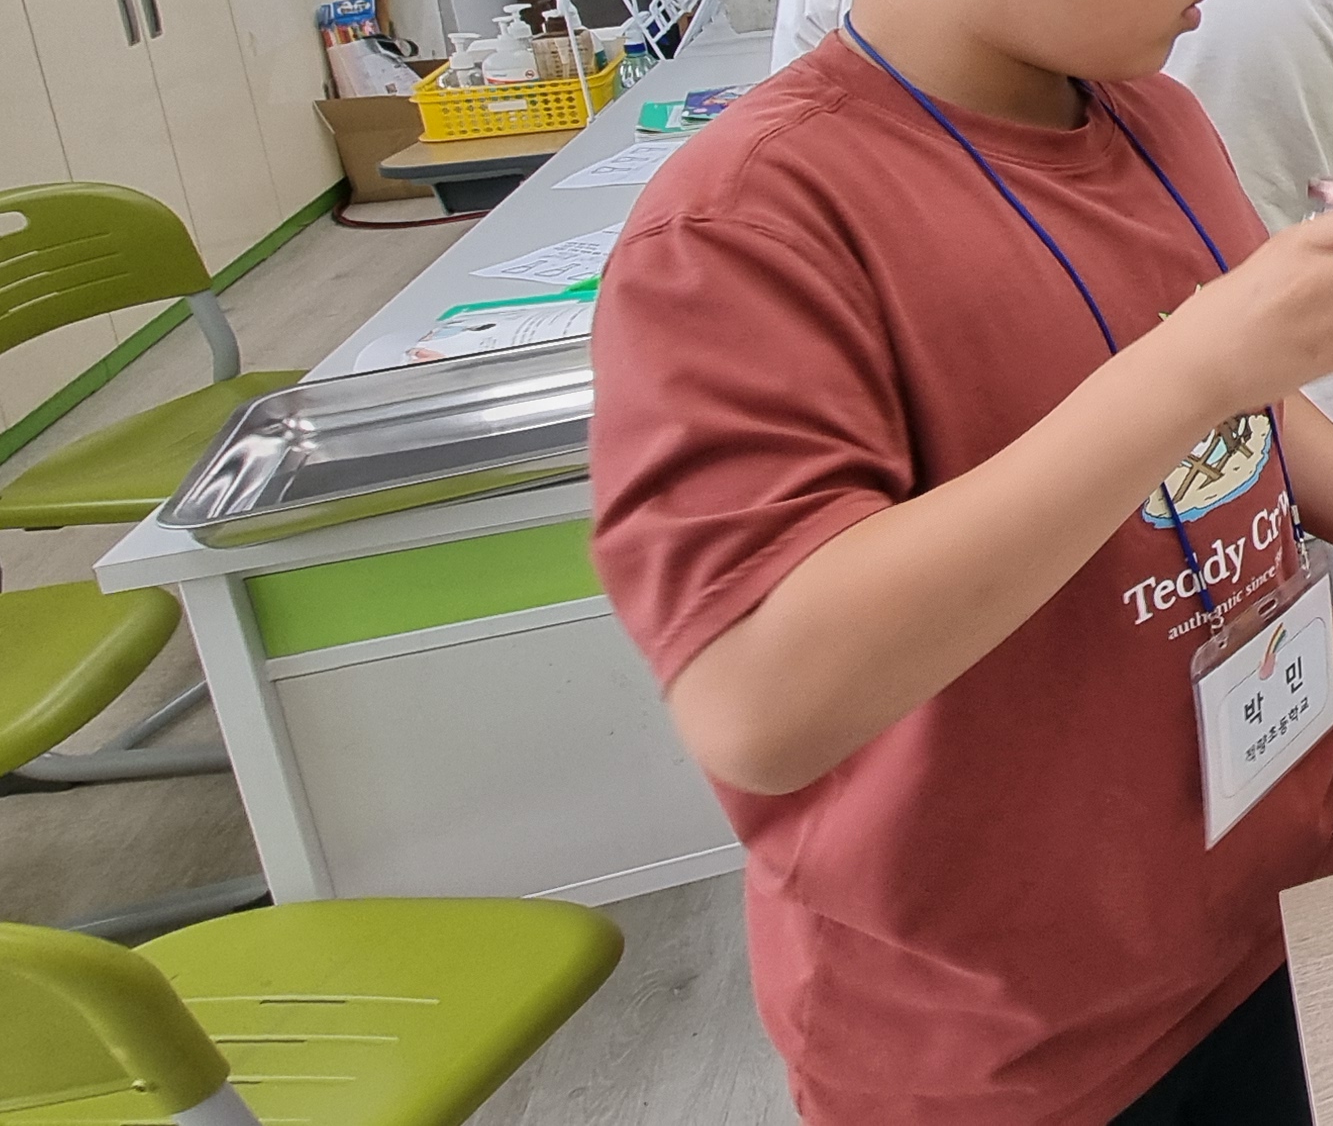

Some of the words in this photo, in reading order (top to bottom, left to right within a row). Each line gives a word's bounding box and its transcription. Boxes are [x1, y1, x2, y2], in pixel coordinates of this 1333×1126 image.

[1122, 537, 1247, 625] Teddy
[1252, 490, 1291, 551] Crw
[1244, 690, 1264, 725] 박
[1285, 656, 1304, 694] 민
